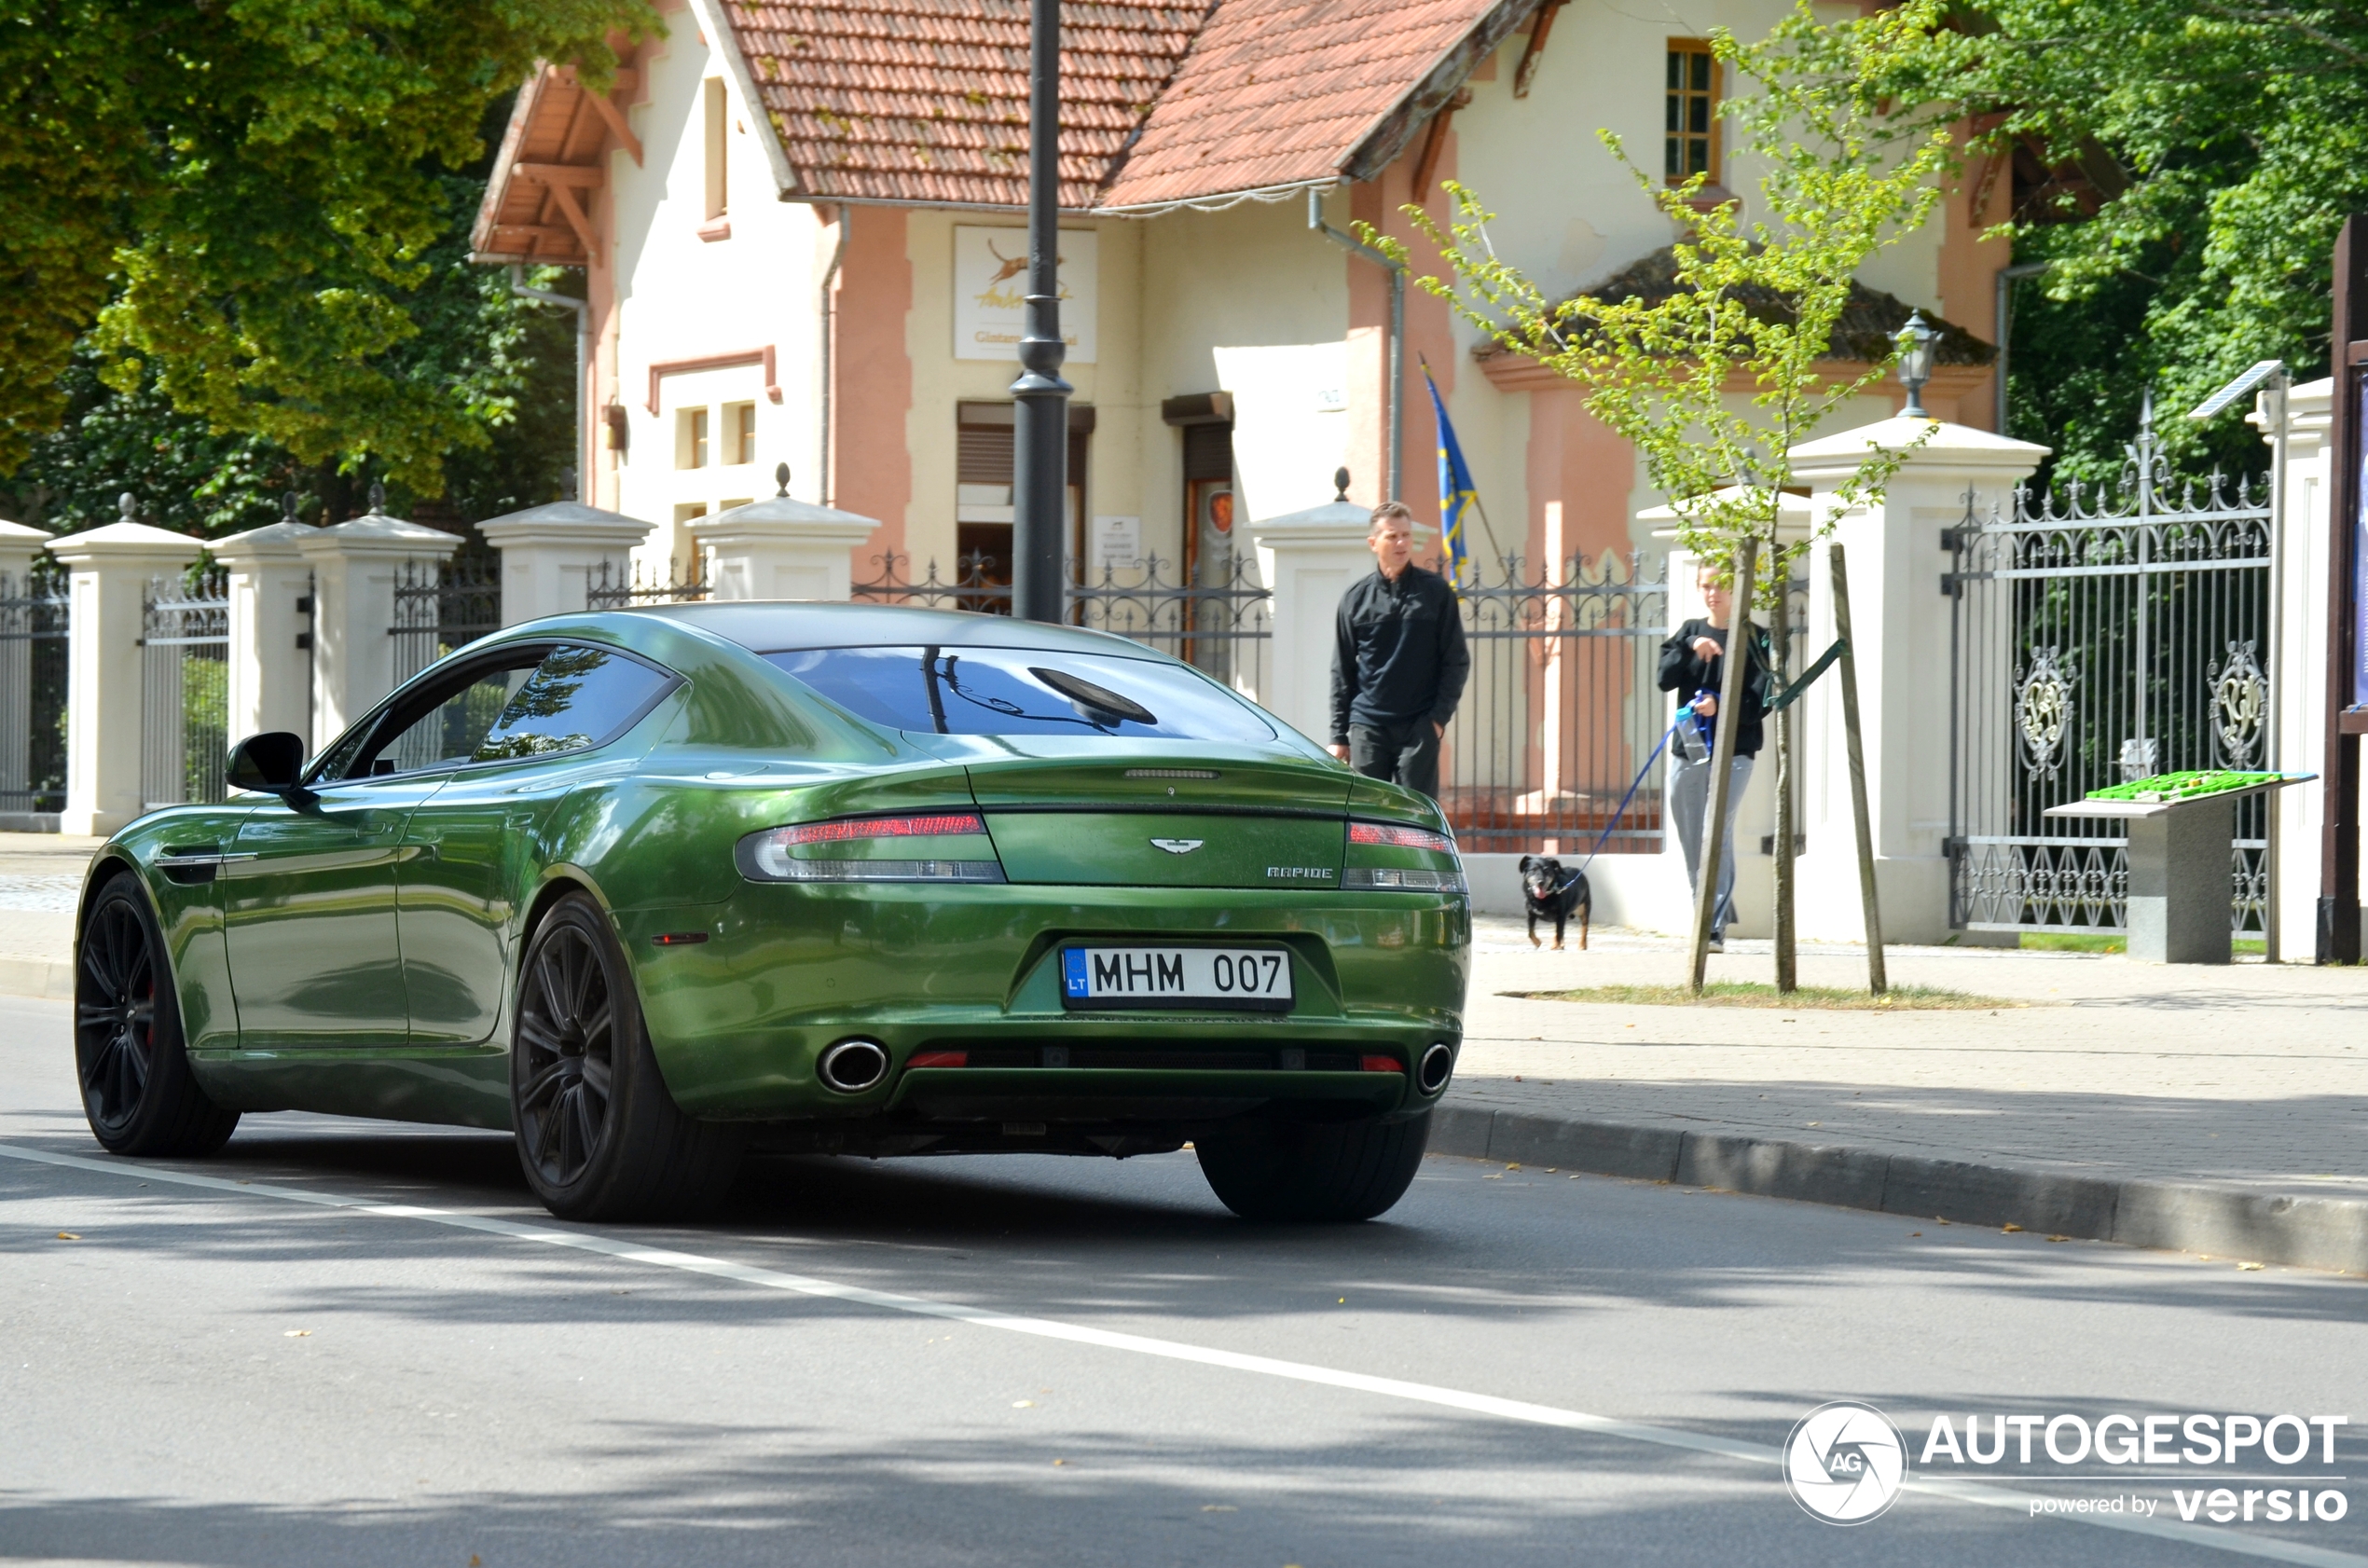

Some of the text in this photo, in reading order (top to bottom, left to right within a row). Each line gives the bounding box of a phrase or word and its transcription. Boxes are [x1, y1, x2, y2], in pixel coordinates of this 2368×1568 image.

[1267, 866, 1333, 879] RAPIDE
[1094, 953, 1282, 993] MHM 007
[1068, 978, 1086, 990] LT
